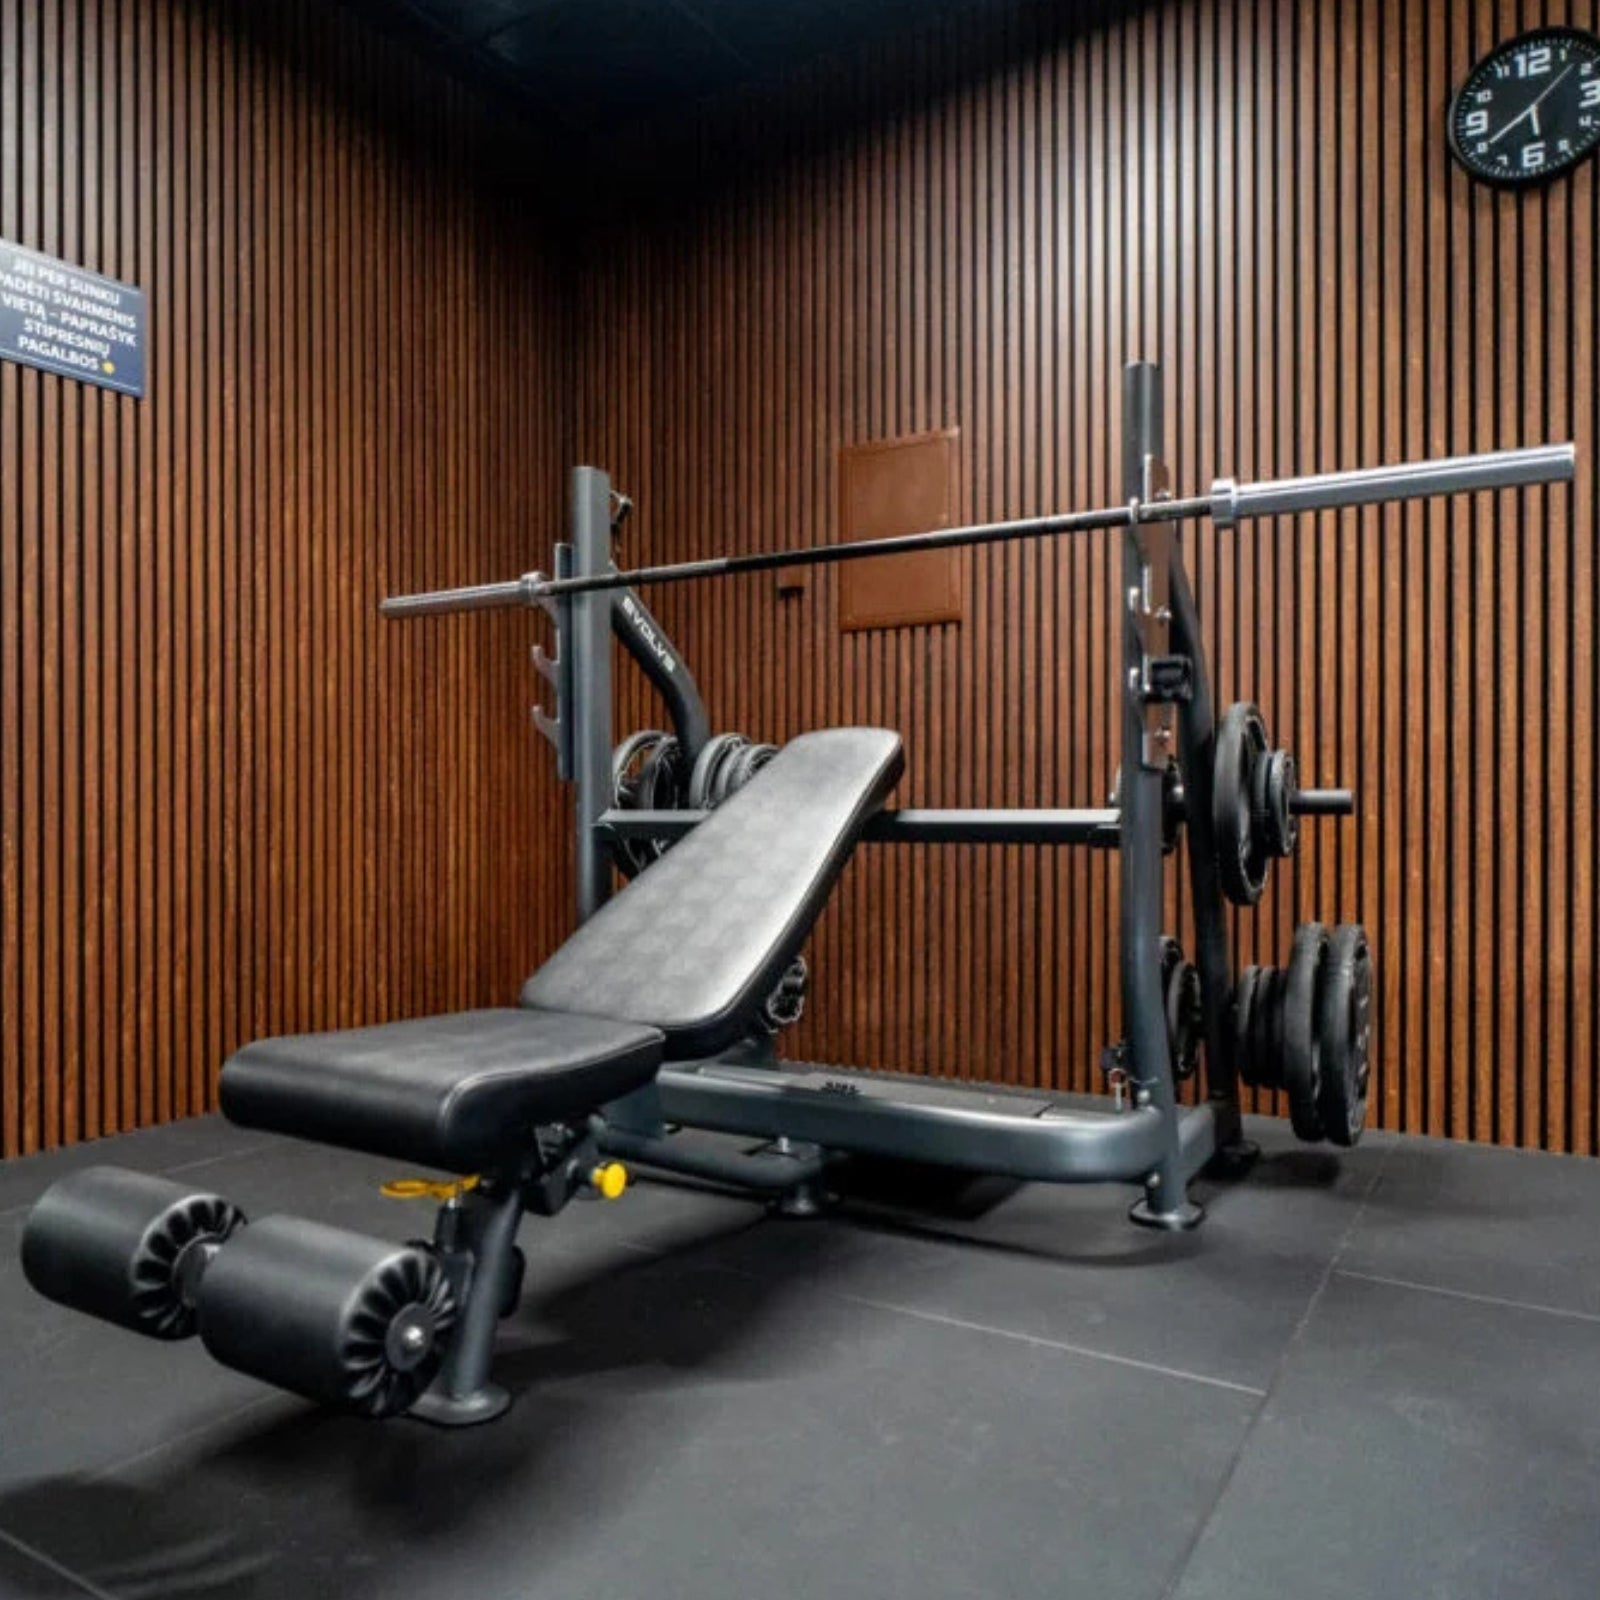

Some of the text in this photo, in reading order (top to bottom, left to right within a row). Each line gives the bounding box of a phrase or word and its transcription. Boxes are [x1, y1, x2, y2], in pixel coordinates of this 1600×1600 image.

[1514, 48, 1551, 78] 12
[1476, 89, 1492, 102] 10
[1579, 80, 1600, 108] 3
[1466, 110, 1488, 136] 9
[1497, 154, 1508, 165] 7
[1523, 141, 1546, 167] 6
[18, 334, 99, 371] PAGALBOS
